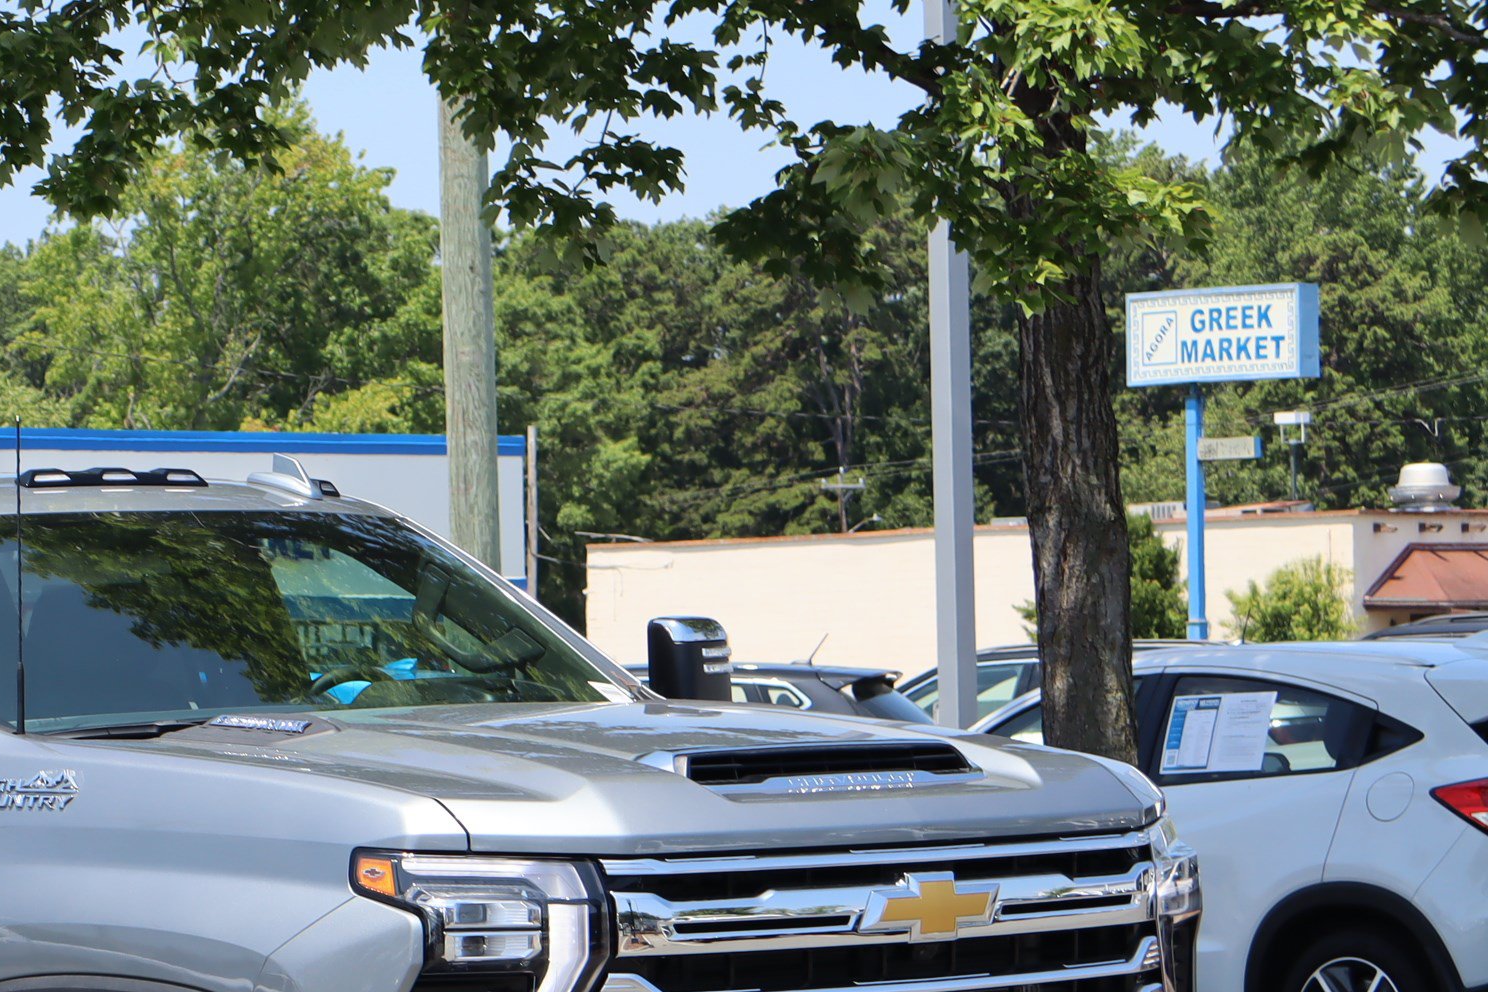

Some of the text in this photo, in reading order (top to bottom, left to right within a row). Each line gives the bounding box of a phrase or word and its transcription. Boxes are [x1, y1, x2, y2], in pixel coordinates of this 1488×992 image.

[1190, 304, 1273, 333] GREEK
[1144, 316, 1174, 361] AGORA
[1180, 335, 1285, 364] MARKET
